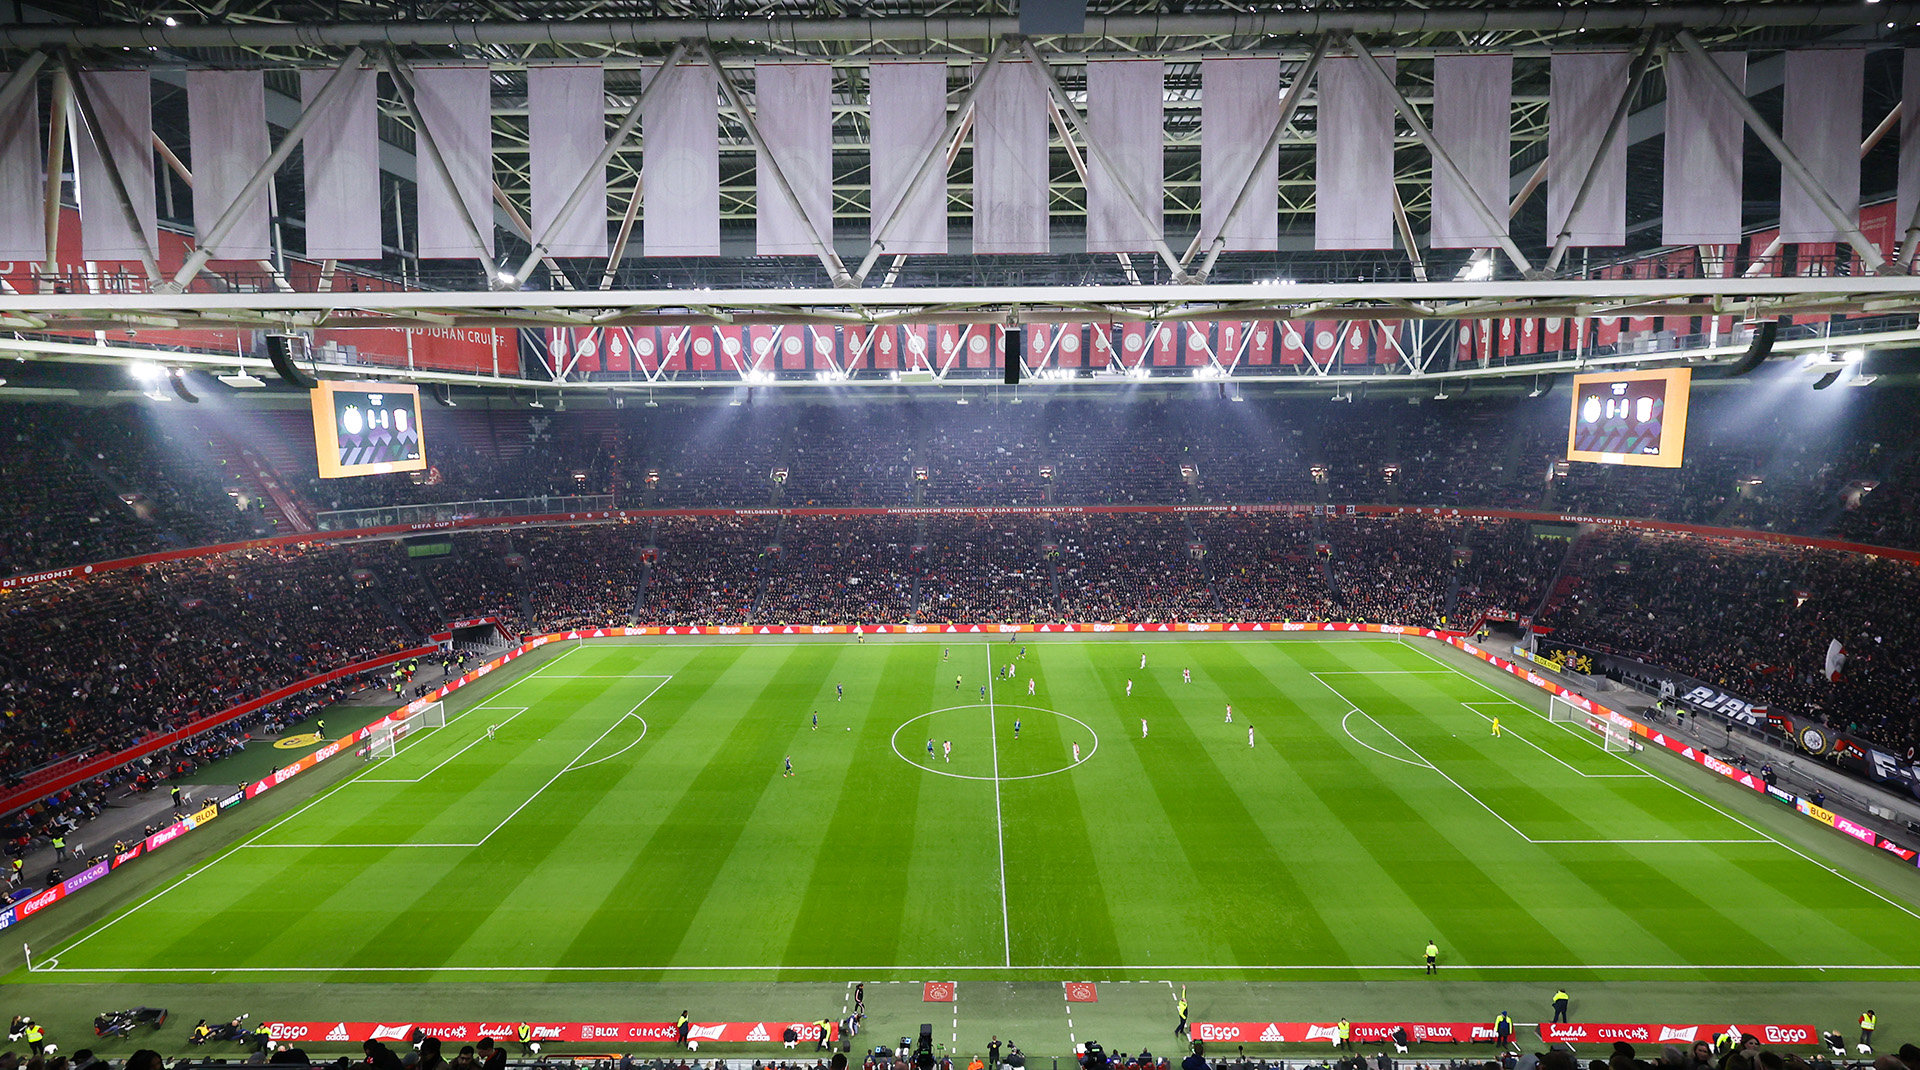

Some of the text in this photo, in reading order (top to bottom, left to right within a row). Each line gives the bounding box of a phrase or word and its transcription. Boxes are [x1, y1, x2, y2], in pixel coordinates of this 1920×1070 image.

[427, 328, 465, 341] JOHAN
[468, 330, 505, 347] CRUIFF
[356, 517, 381, 528] VAK
[411, 522, 432, 530] UEFA
[1560, 515, 1594, 523] EUROPA
[3, 569, 74, 587] DE TOEKOMST
[219, 790, 244, 809] UNIBET
[1767, 784, 1794, 802] UNIBET
[195, 807, 216, 823] BLOX
[1810, 806, 1833, 823] BLOX
[152, 824, 178, 848] Flink
[1838, 820, 1868, 840] Flink
[1884, 839, 1907, 856] Bud
[117, 848, 138, 864] Bud
[68, 865, 104, 890] CURAÇAO
[477, 1023, 513, 1036] Sandals
[531, 1026, 563, 1038] Flink
[595, 1027, 619, 1037] BLOX
[1427, 1027, 1452, 1037] BLOX
[1550, 1024, 1587, 1037] Sandals
[746, 1034, 770, 1042] adidas
[1259, 1034, 1285, 1042] adidas
